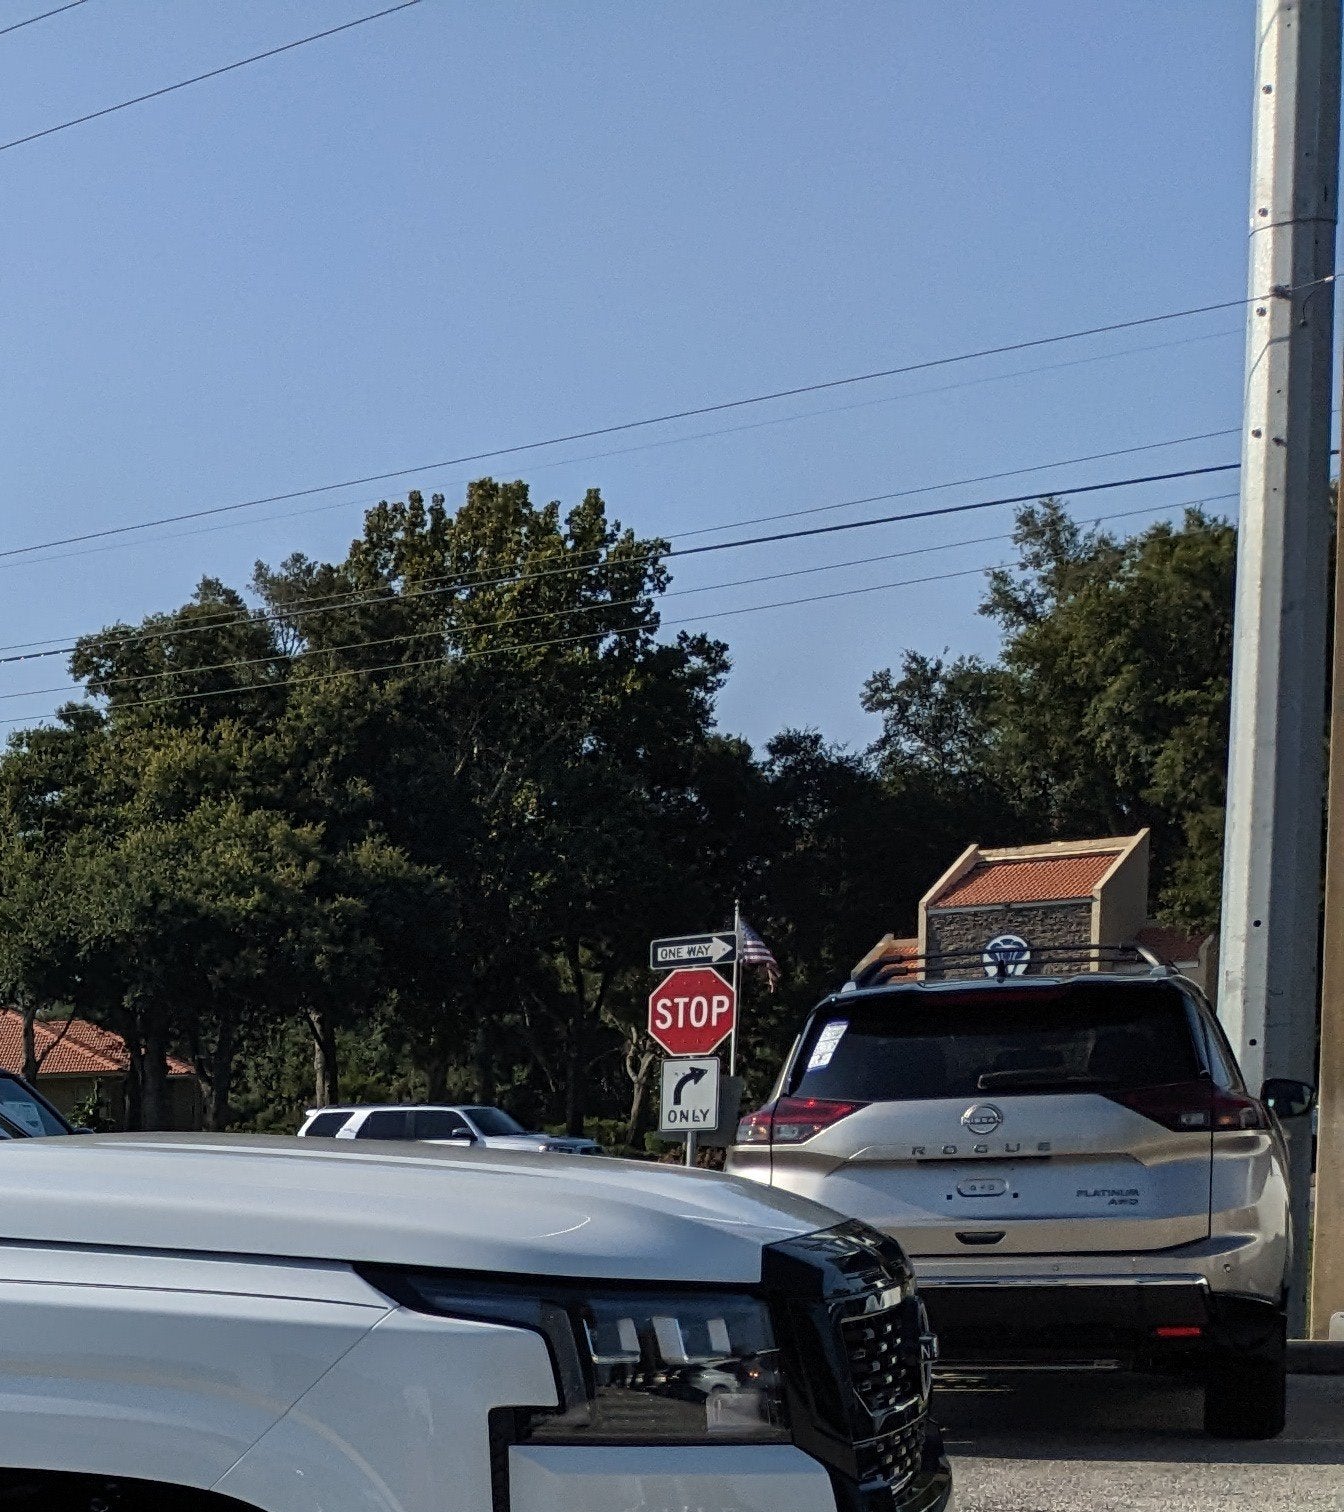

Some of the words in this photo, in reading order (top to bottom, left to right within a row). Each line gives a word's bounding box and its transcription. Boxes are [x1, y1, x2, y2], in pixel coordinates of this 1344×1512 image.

[660, 947, 683, 960] ONE
[687, 944, 712, 957] WAY
[655, 995, 730, 1030] STOP
[667, 1108, 710, 1124] ONLY
[912, 1142, 1052, 1156] ROGUE
